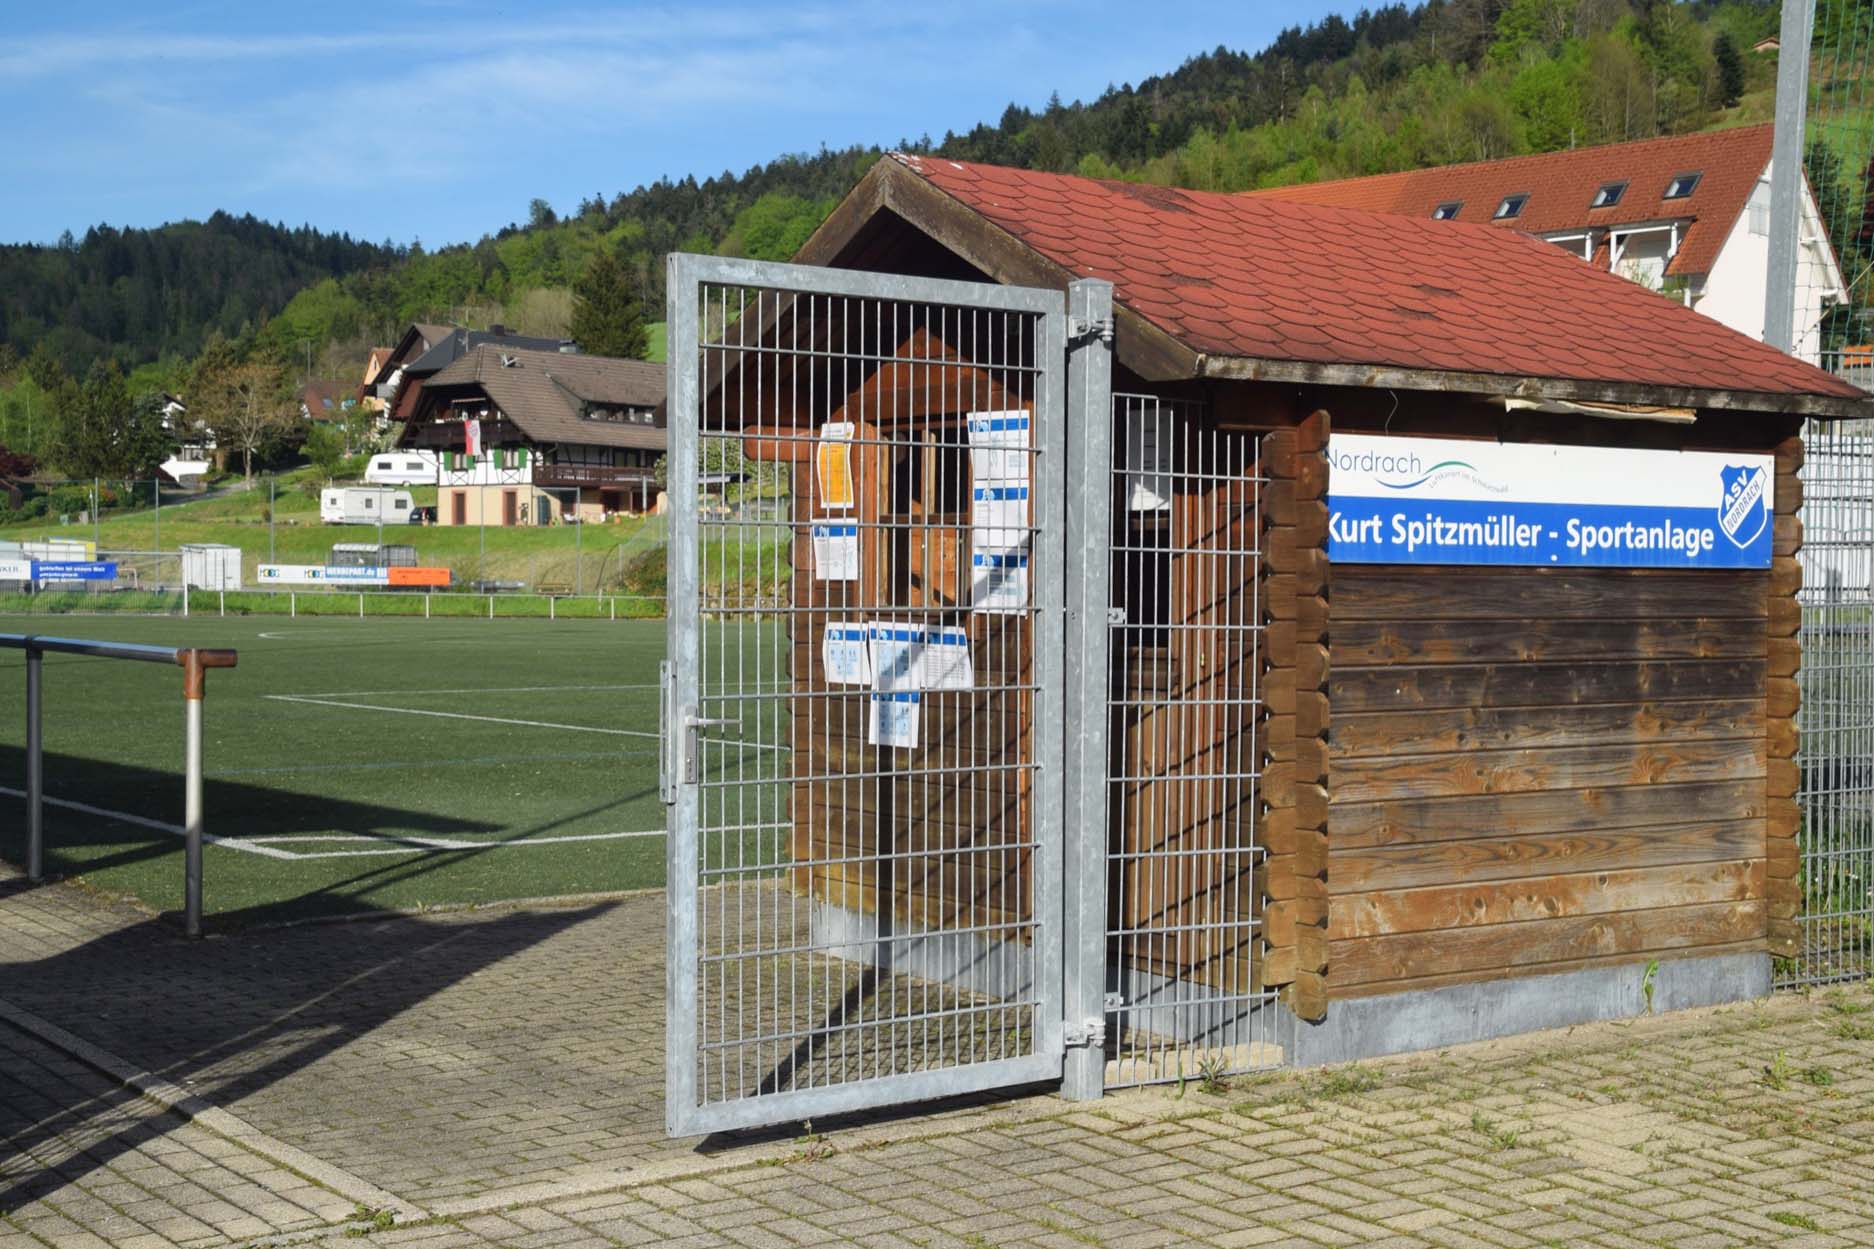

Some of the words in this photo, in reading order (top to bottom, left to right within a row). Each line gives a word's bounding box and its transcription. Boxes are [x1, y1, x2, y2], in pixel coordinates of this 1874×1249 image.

[1326, 449, 1422, 474] Nordrach
[1724, 469, 1749, 512] ASV
[1726, 480, 1761, 529] NORDRACH
[1328, 511, 1383, 544] Kurt
[1391, 512, 1542, 553] Spitzmüller
[1566, 518, 1715, 557] Sportanlage
